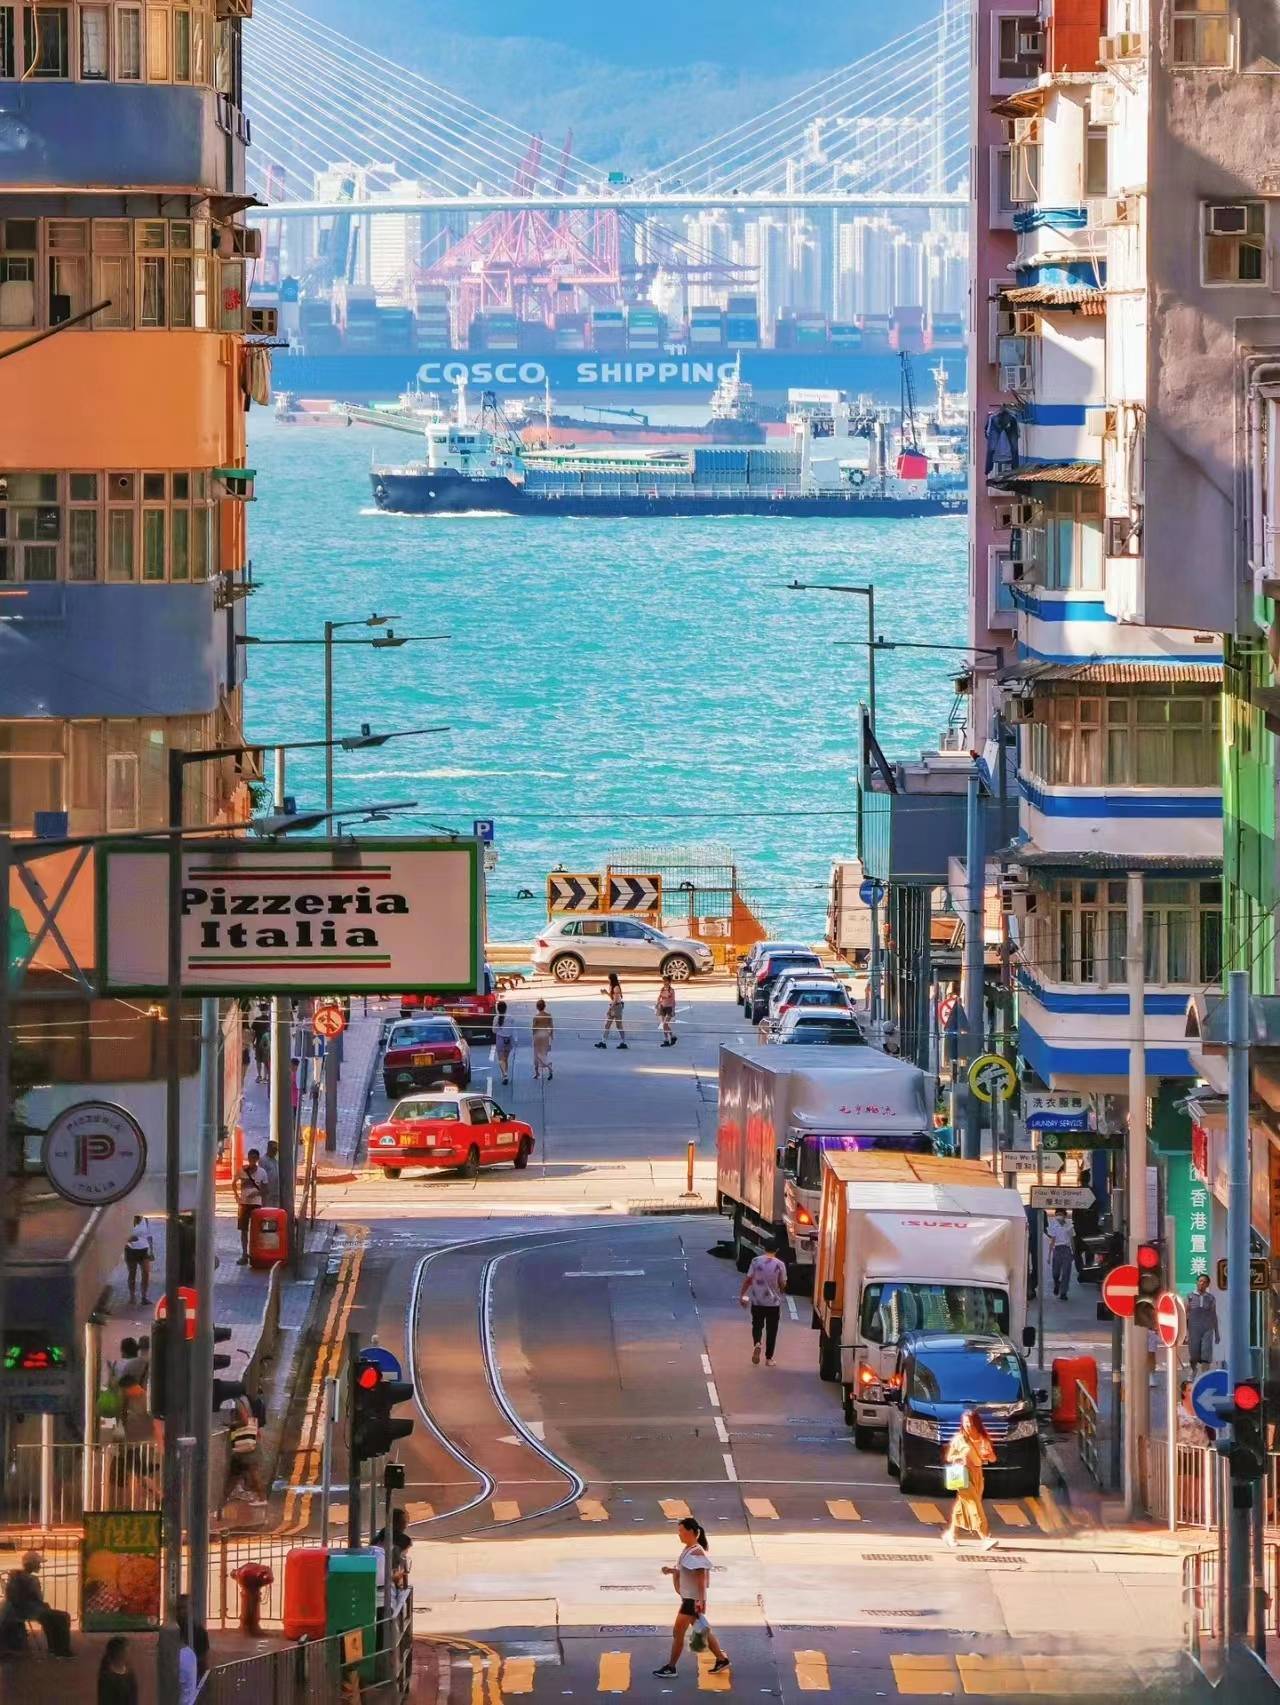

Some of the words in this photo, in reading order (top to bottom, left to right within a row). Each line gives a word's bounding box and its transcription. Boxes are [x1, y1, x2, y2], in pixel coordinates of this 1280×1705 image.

[418, 362, 545, 384] COSCO
[477, 822, 490, 837] P
[181, 886, 409, 915] Pizzeria
[200, 920, 379, 948] Italia
[901, 1220, 968, 1229] ISUZU
[1190, 1189, 1208, 1276] 香港置業
